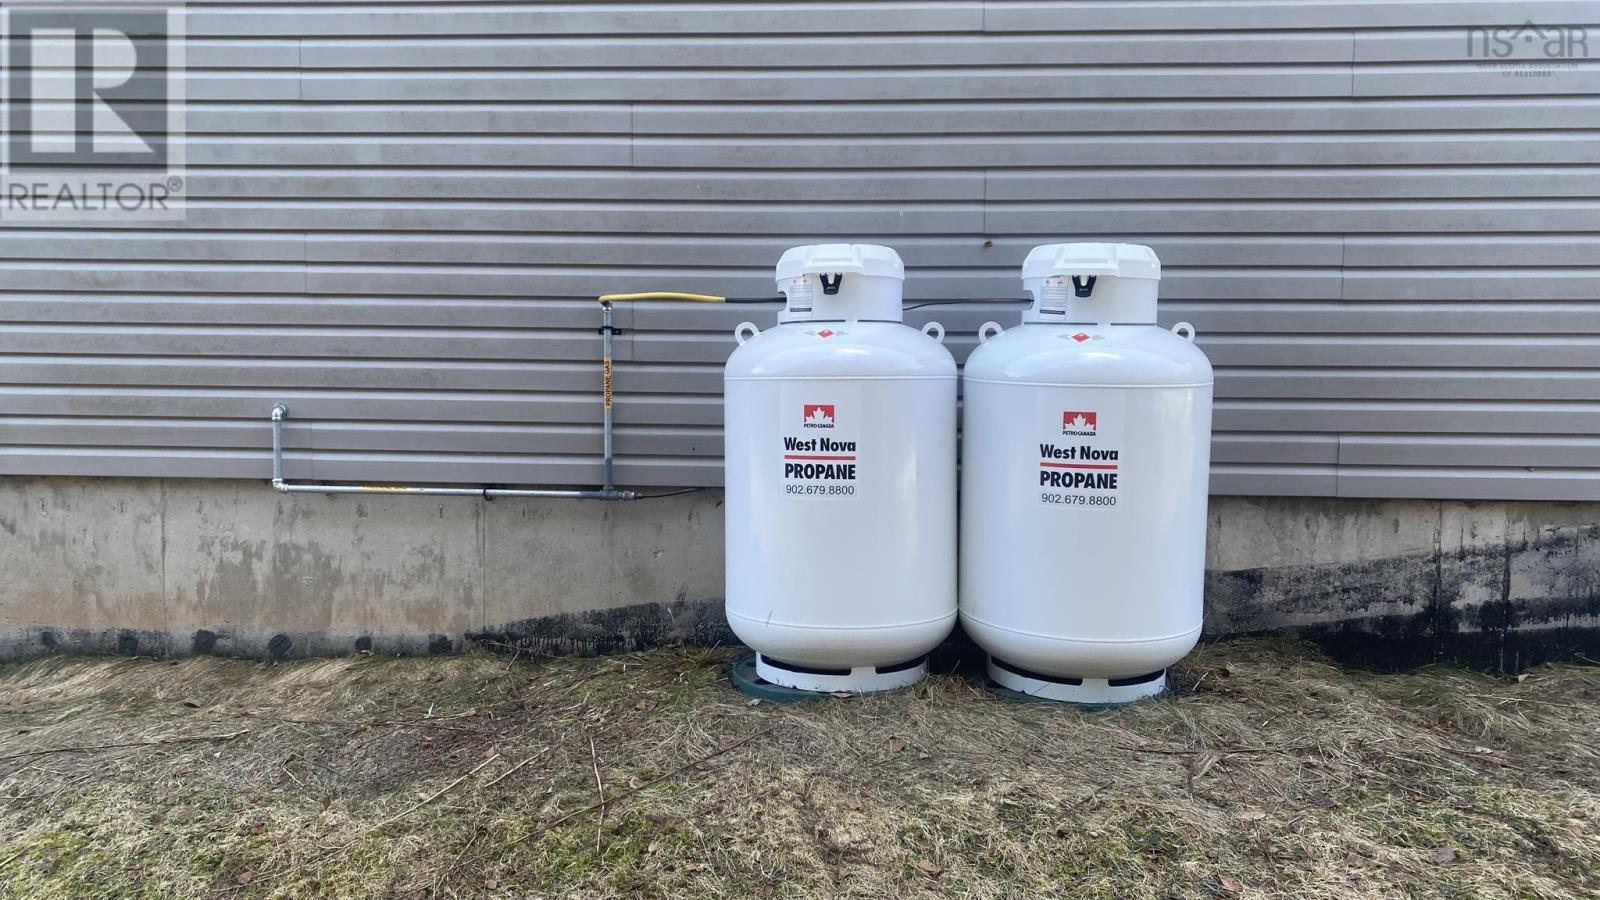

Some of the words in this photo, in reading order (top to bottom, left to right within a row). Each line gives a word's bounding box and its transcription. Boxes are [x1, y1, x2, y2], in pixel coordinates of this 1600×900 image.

[784, 437, 817, 451] West
[820, 438, 856, 452] Nova
[1040, 444, 1077, 459] West
[1080, 446, 1119, 461] Nova
[784, 463, 856, 480] PROPANE
[1040, 471, 1118, 489] PROPANE
[786, 485, 855, 495] 902.679.8800
[1041, 493, 1117, 506] 902.679.8800
